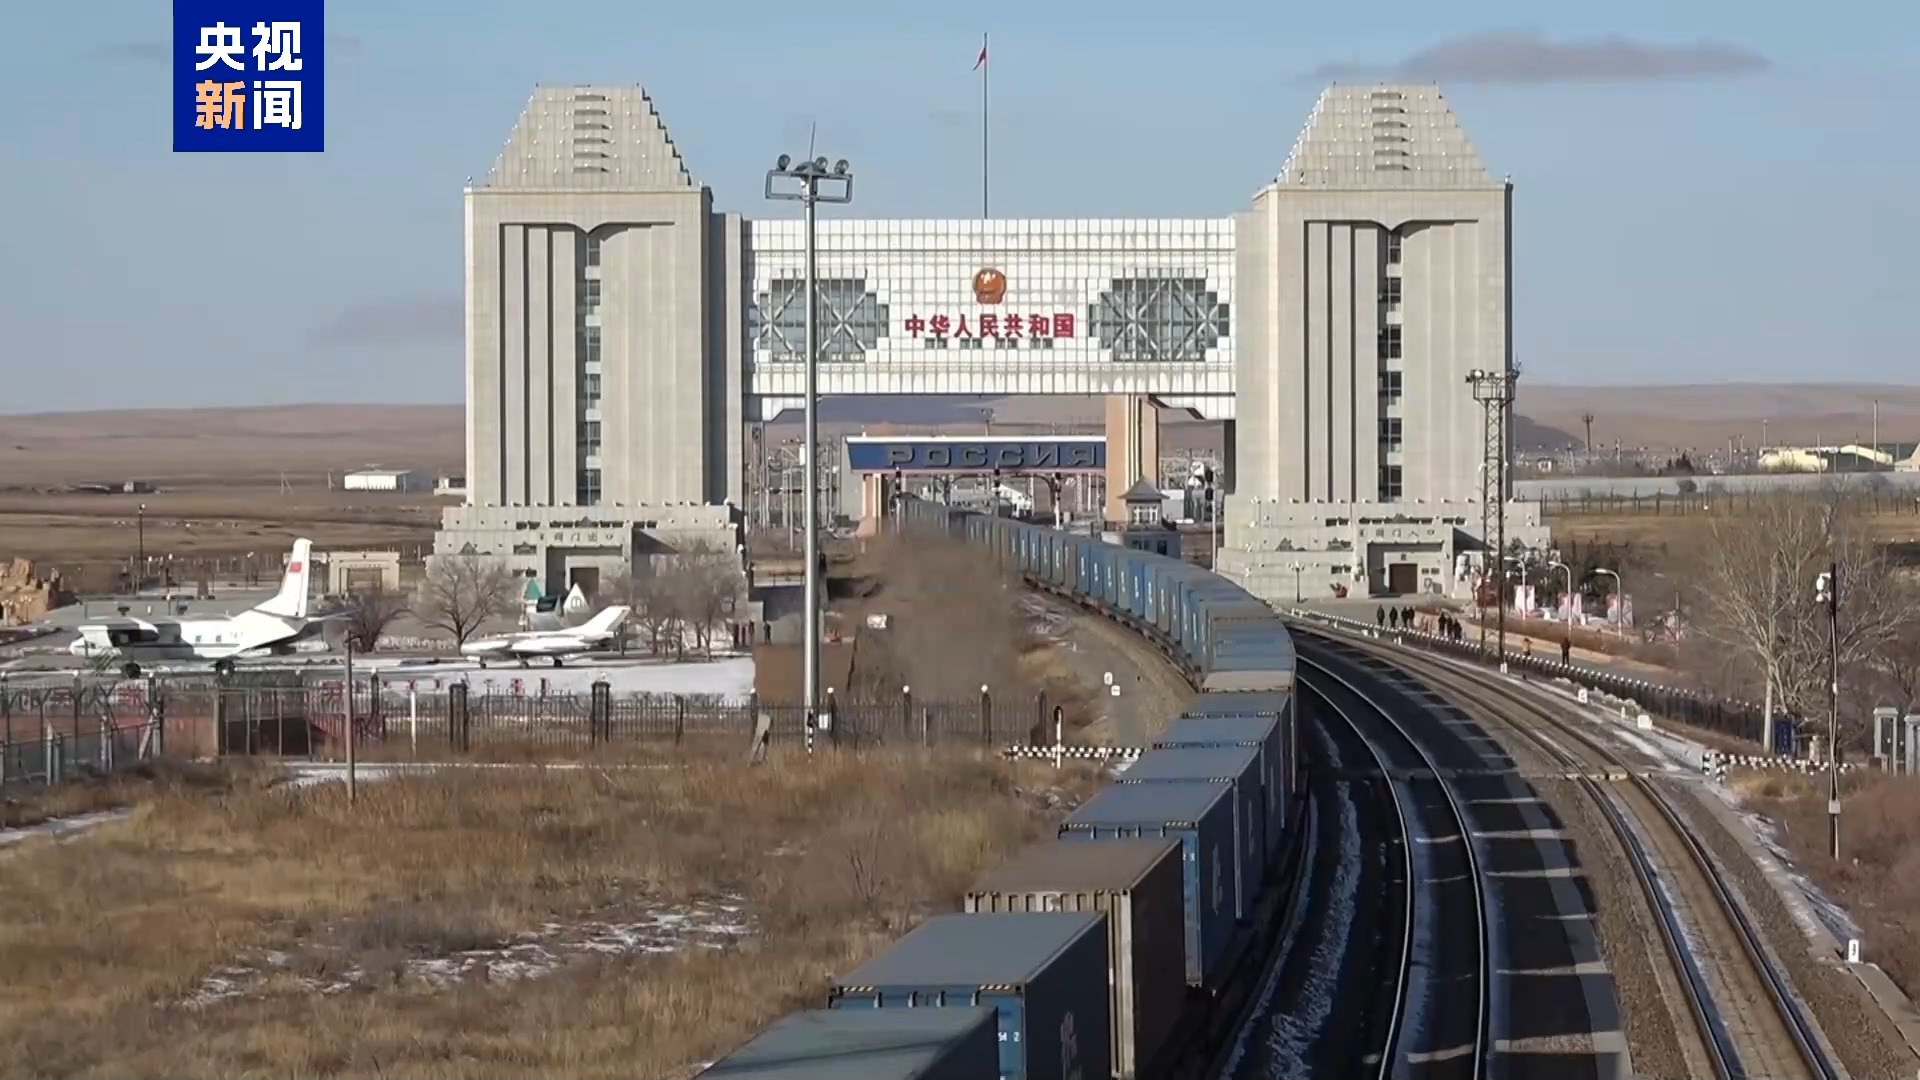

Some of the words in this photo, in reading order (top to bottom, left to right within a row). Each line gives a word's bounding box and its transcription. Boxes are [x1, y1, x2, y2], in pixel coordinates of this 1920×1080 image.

[904, 313, 1074, 338] 中华人民共和国
[888, 444, 1096, 467] РОССИЯ
